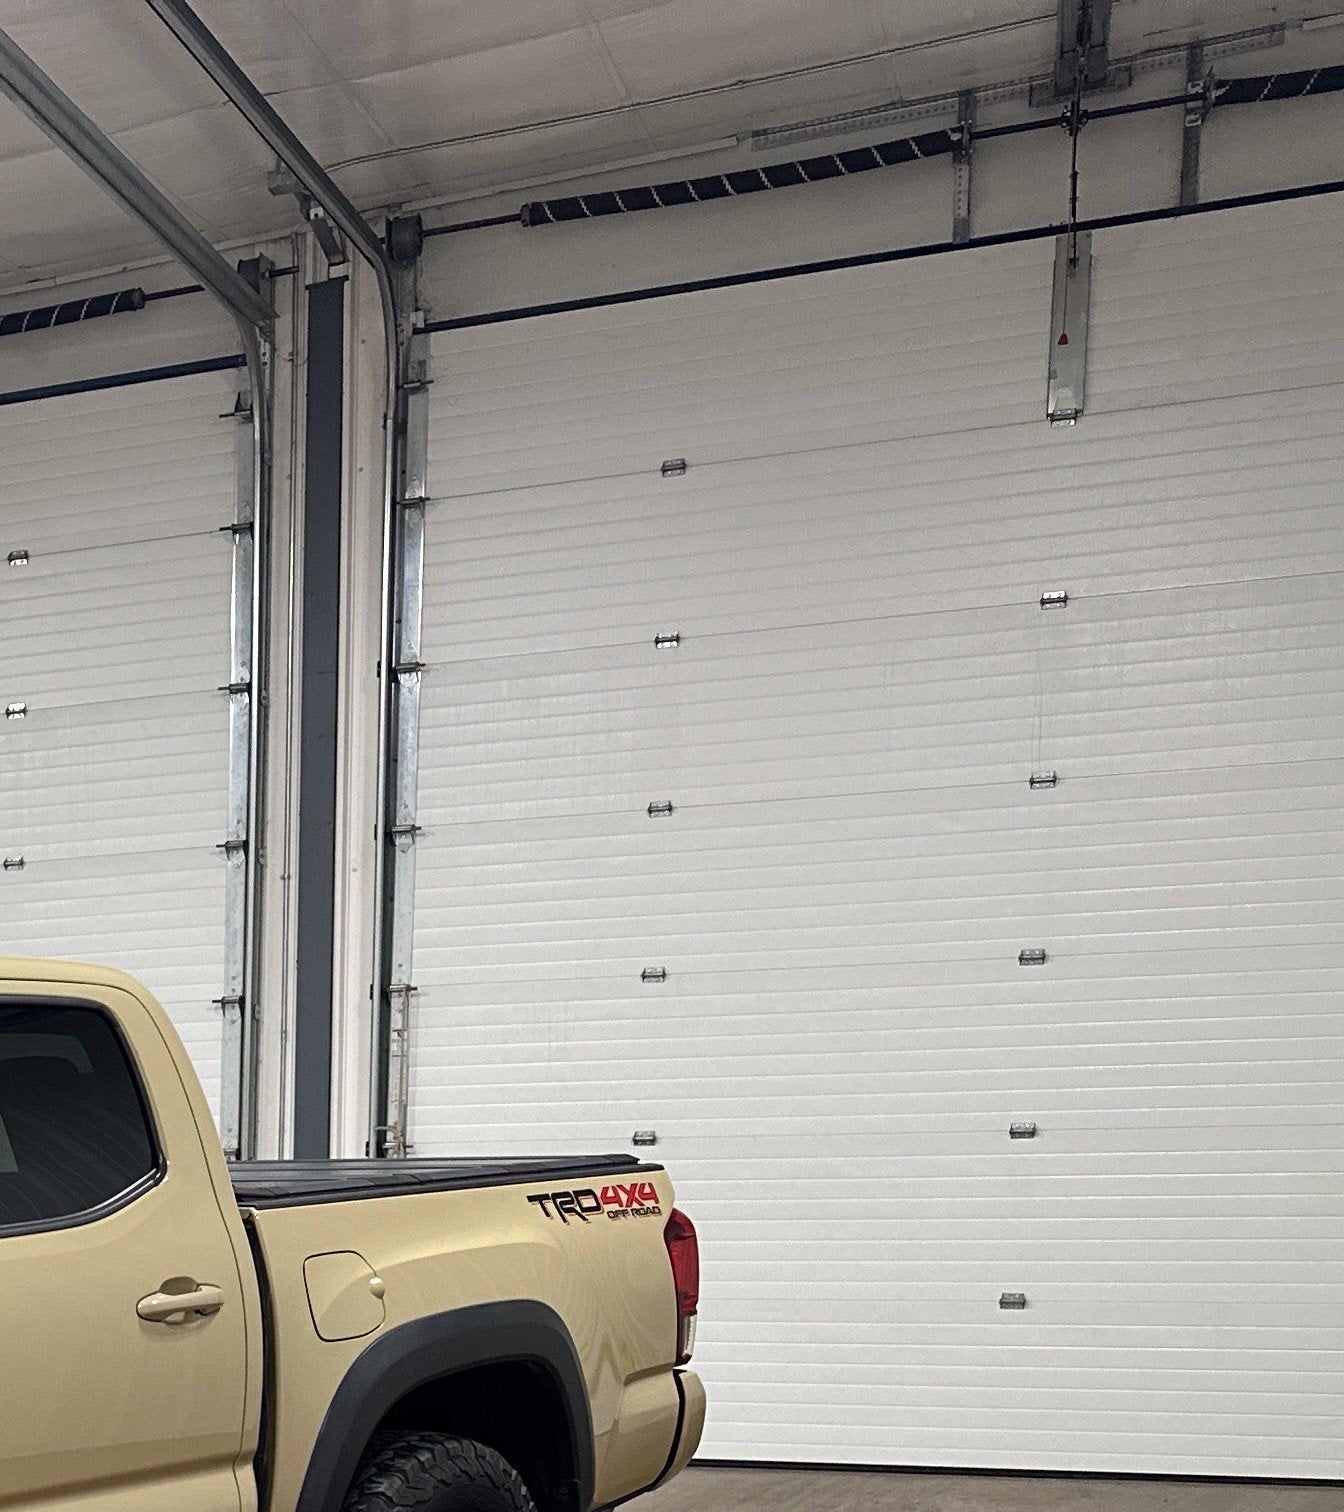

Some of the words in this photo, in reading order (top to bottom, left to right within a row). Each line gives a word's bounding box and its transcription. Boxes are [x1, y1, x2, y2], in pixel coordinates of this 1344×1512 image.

[526, 1188, 604, 1225] TRD
[607, 1209, 630, 1221] OFF
[631, 1205, 662, 1218] ROAD
